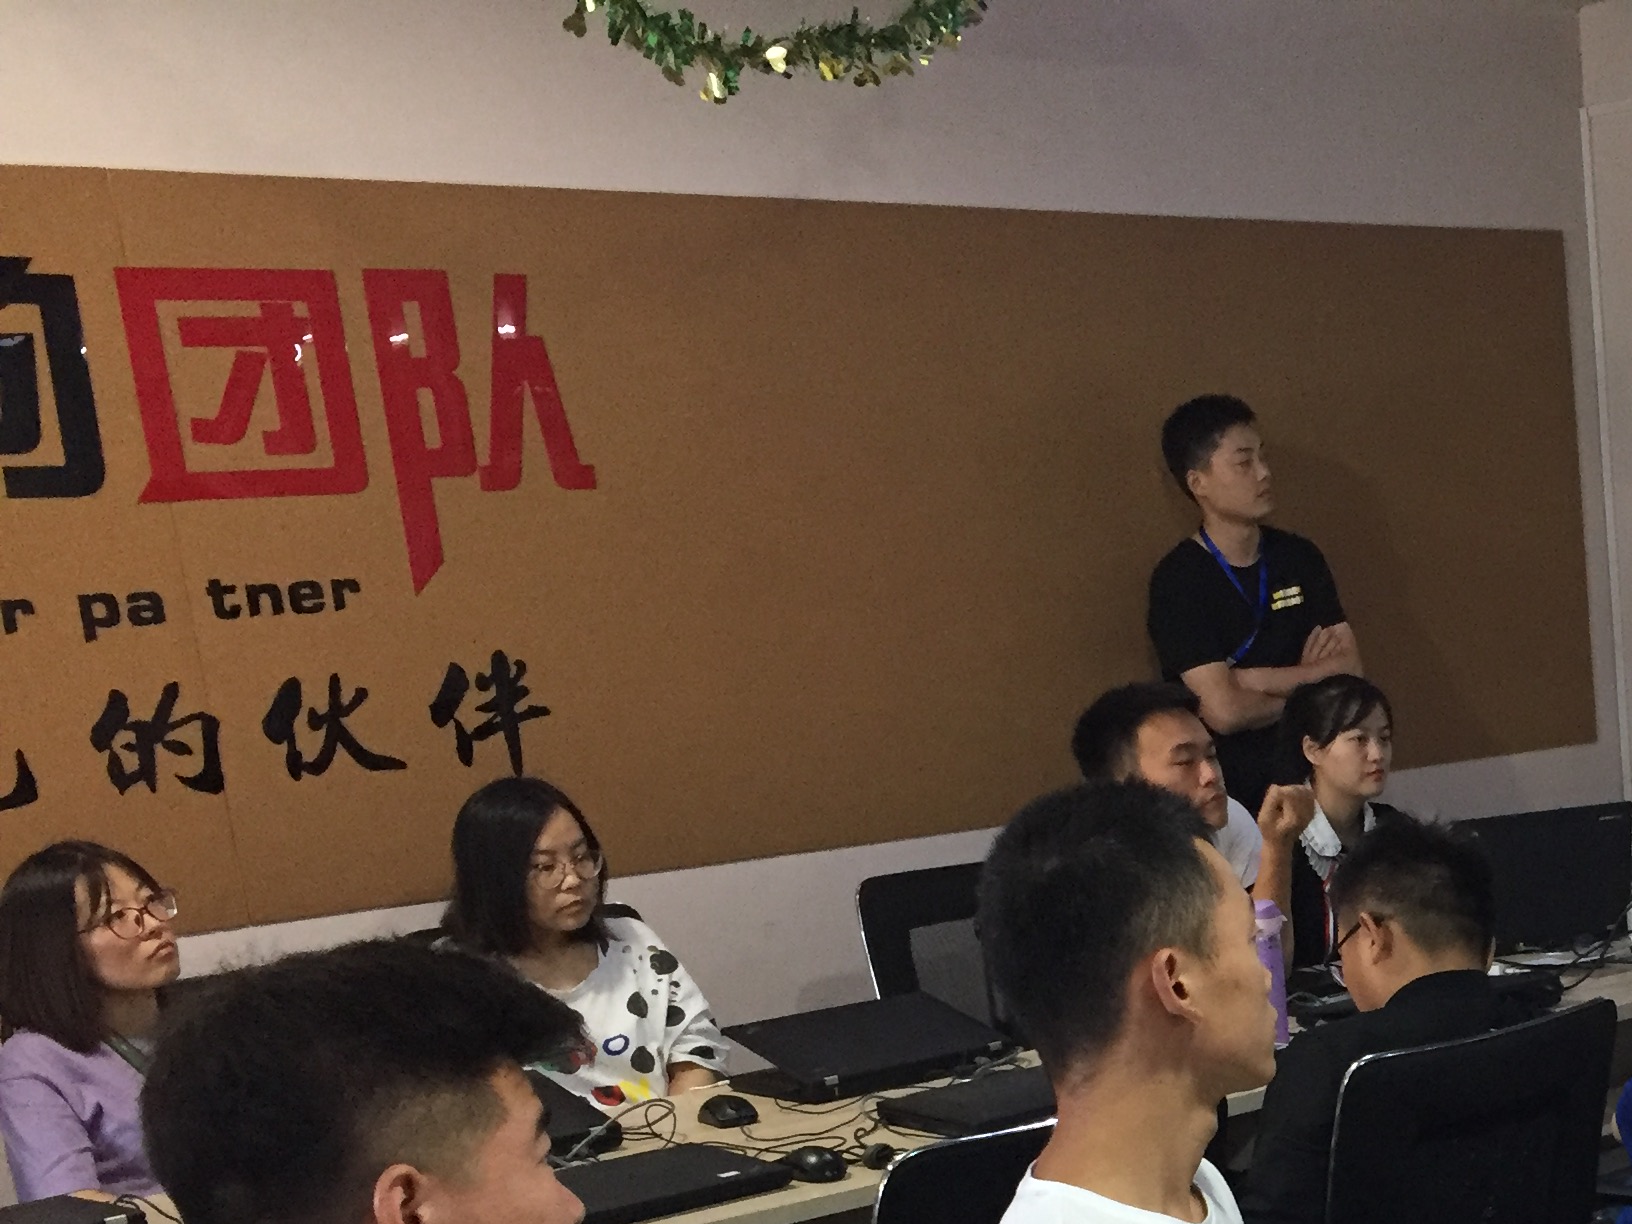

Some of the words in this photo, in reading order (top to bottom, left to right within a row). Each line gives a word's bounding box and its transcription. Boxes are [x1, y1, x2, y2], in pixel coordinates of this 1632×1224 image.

[77, 590, 166, 643] pa
[206, 576, 361, 620] tner
[0, 650, 552, 811] 的伙伴
